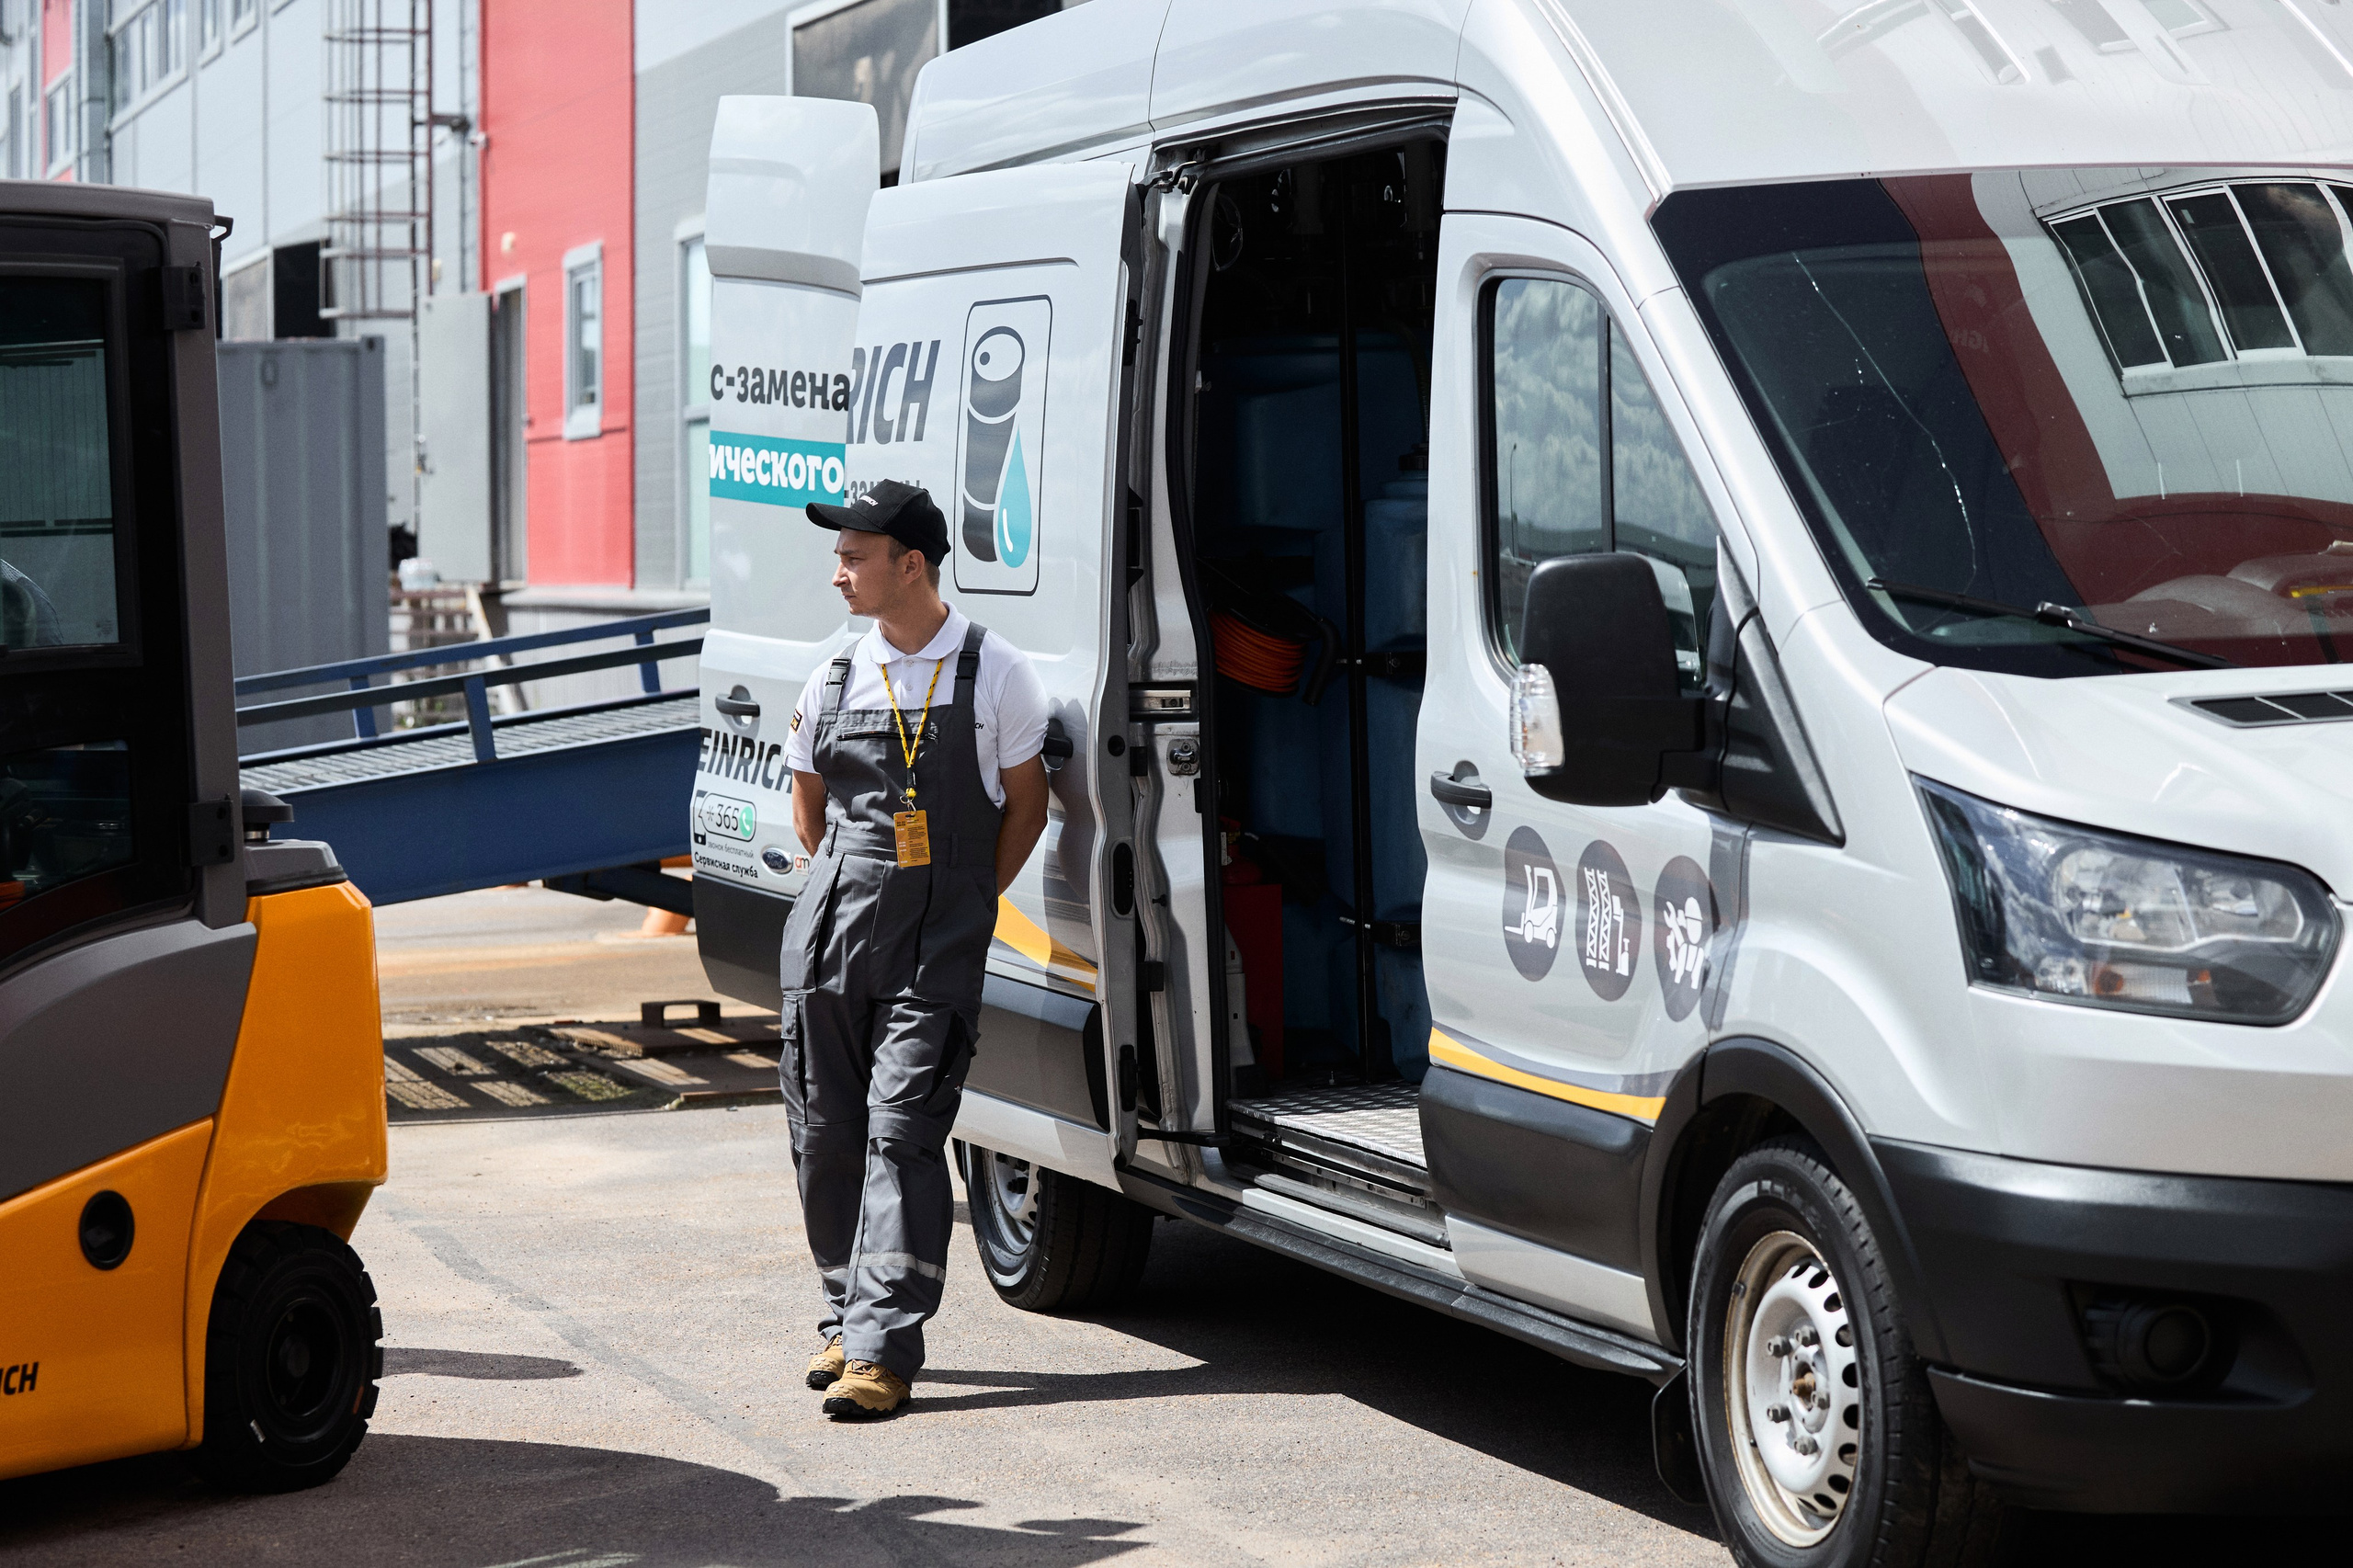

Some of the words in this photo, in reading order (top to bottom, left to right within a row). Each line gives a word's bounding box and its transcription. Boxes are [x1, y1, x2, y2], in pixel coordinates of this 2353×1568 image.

[710, 364, 850, 412] с-замена
[709, 443, 845, 494] ического
[694, 851, 731, 871] Сервисная
[732, 865, 758, 879] служба
